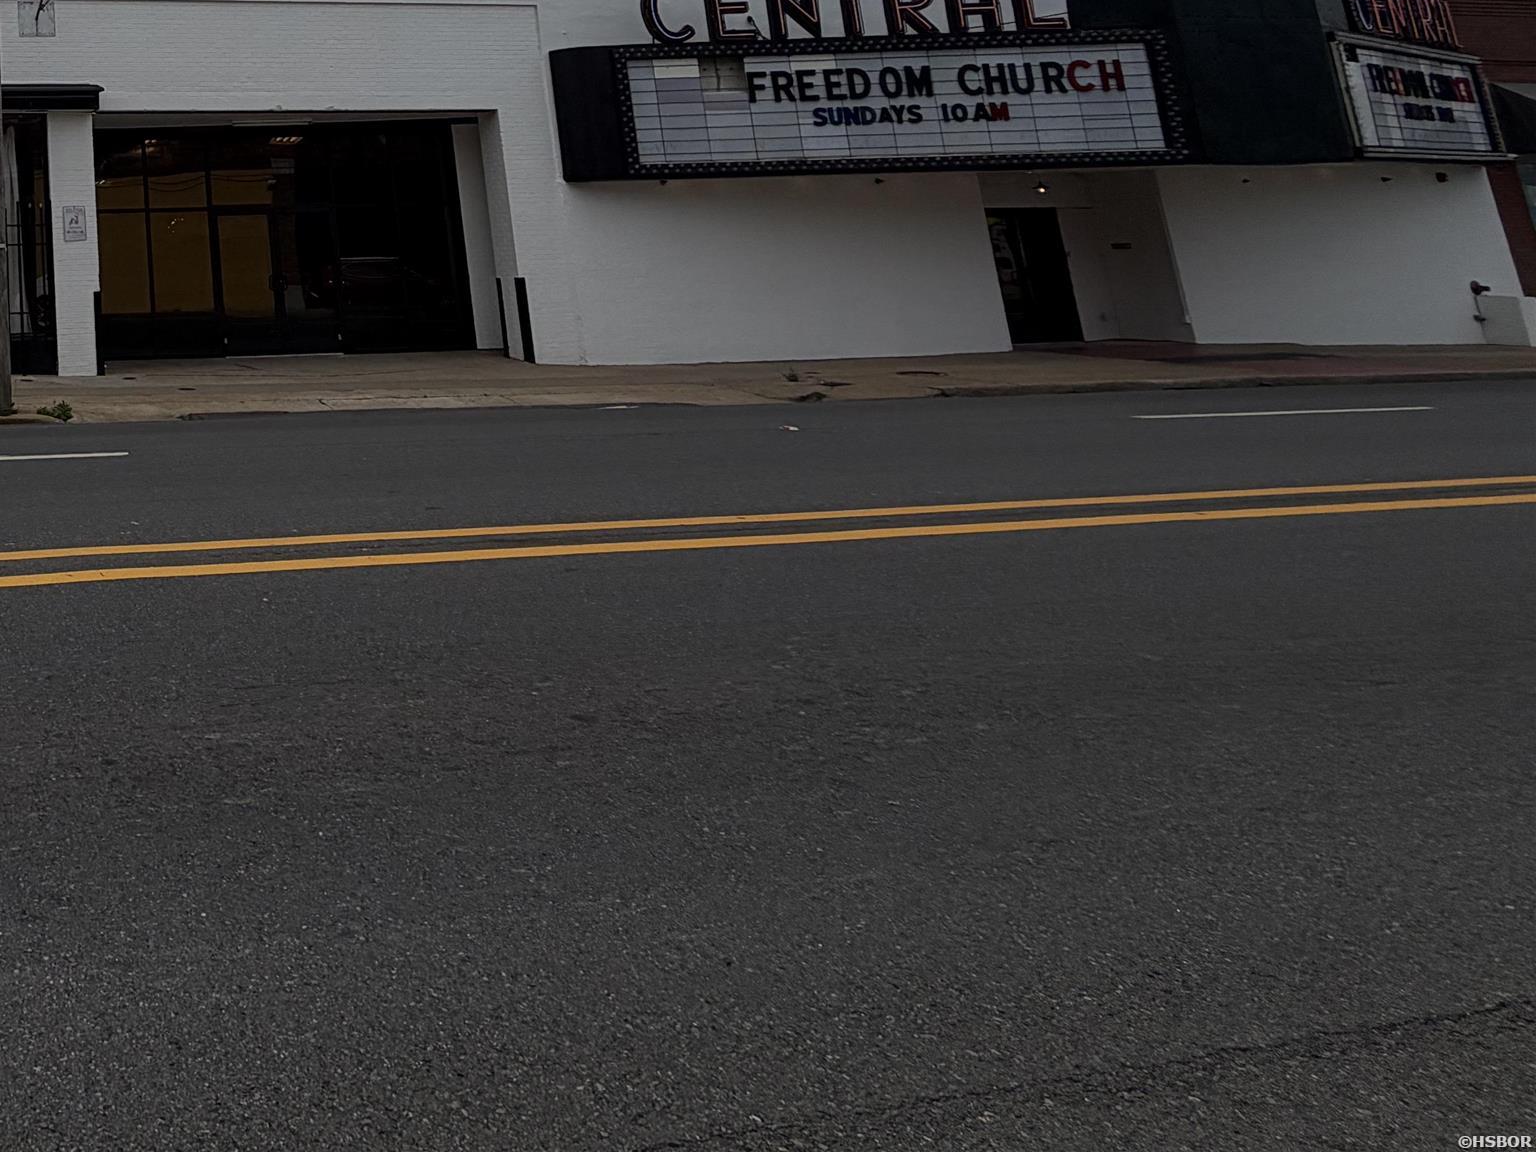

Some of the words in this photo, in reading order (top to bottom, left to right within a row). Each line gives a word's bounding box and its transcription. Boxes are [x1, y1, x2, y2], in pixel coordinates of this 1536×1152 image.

[746, 65, 934, 103] FREEDOM
[957, 59, 1126, 96] CHURCH
[812, 104, 923, 126] SUNDAYS
